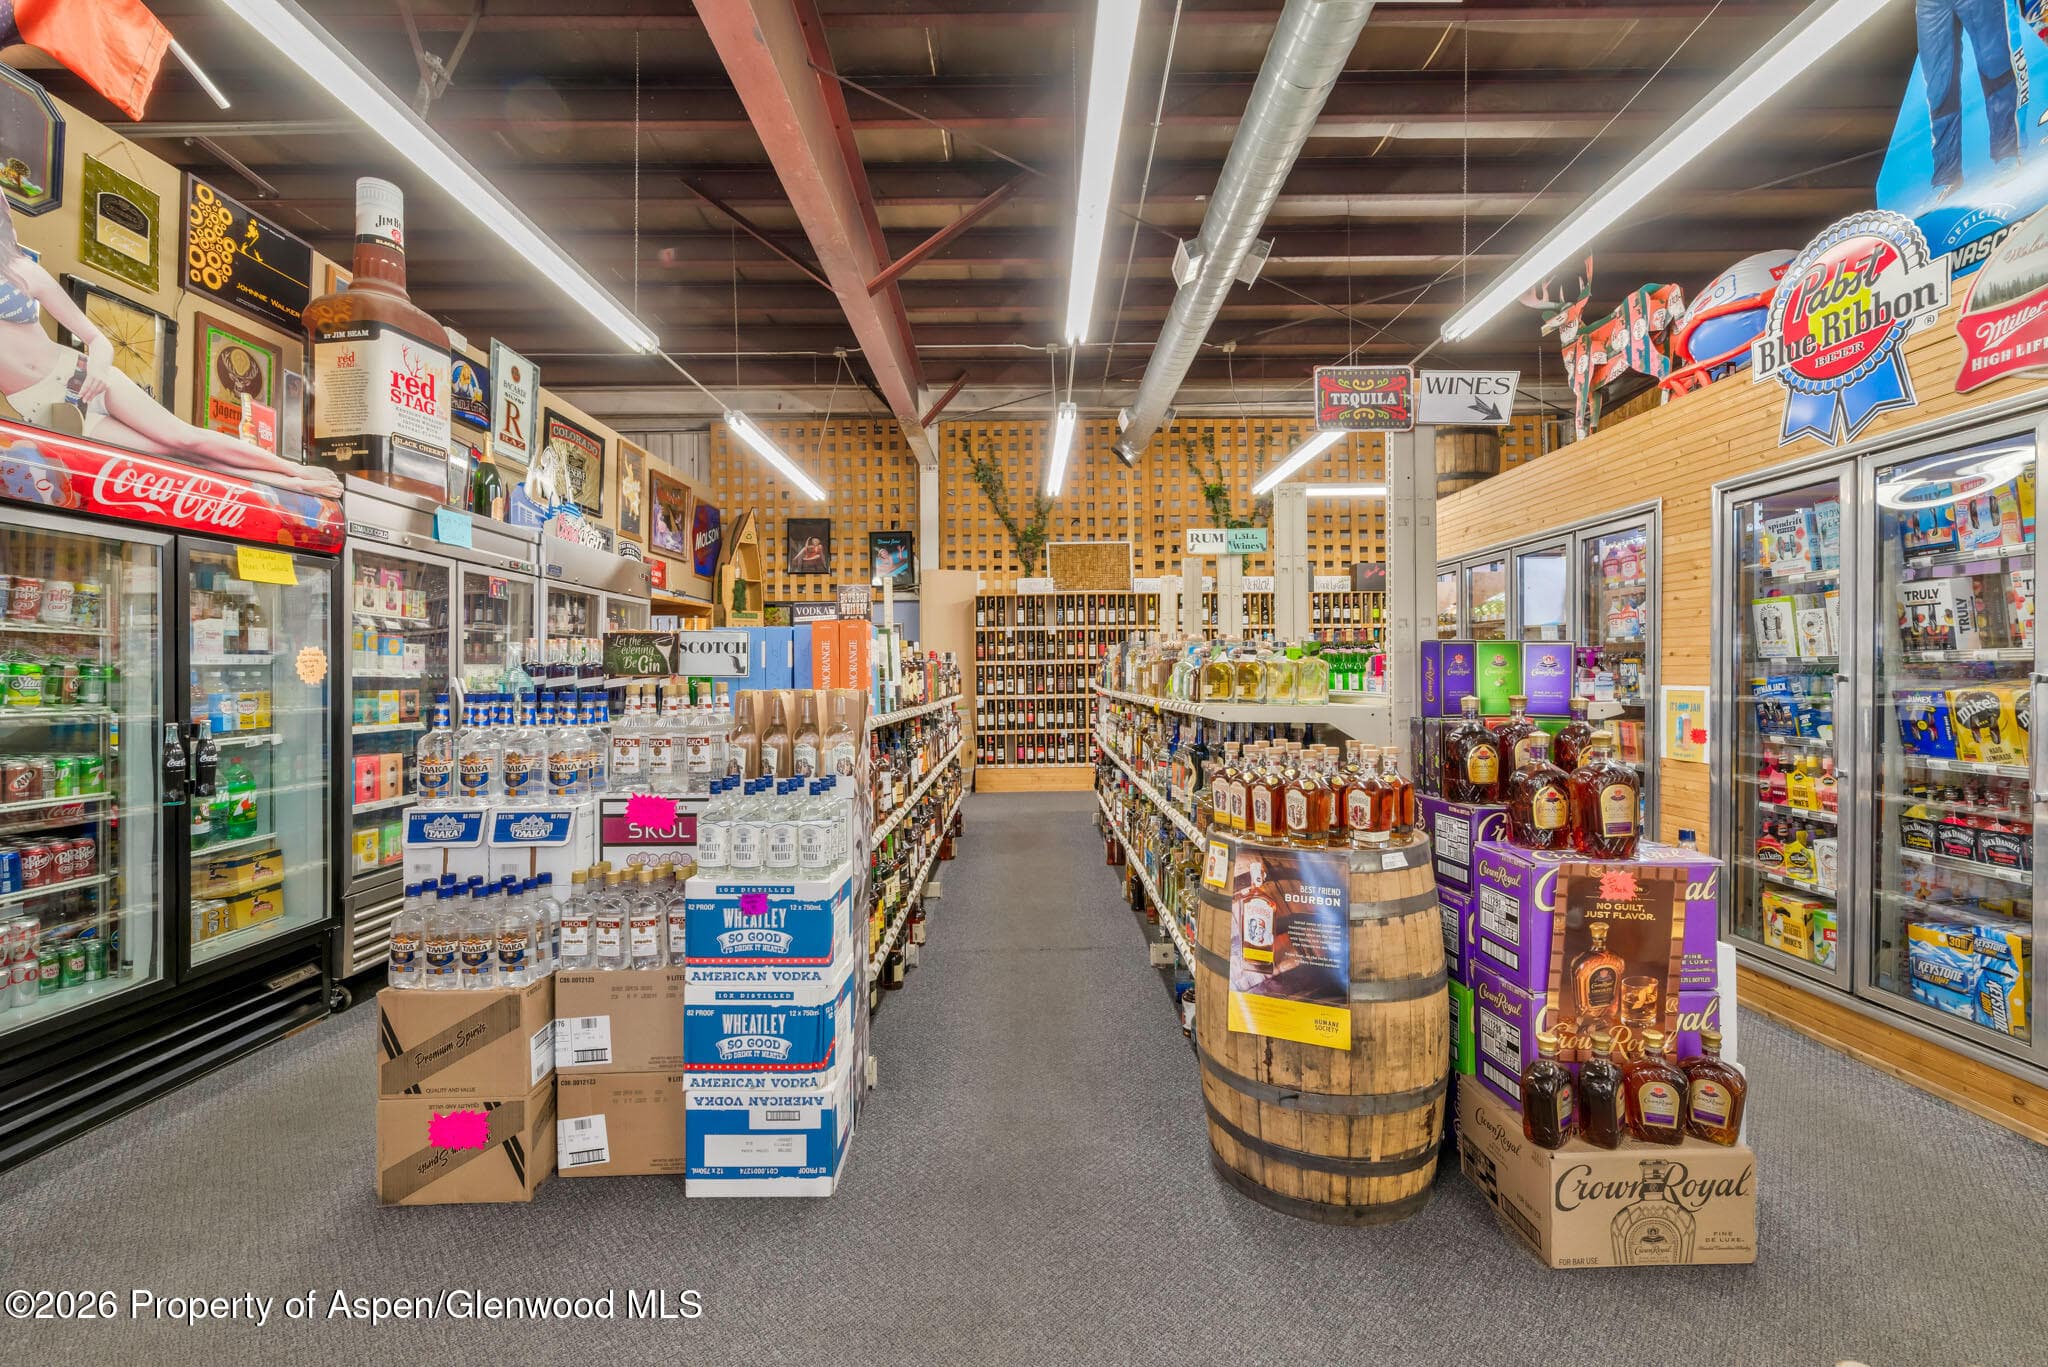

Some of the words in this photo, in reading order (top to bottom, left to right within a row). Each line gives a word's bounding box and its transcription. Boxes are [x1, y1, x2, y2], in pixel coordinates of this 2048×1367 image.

[375, 214, 392, 228] JIM
[1948, 208, 2009, 244] OFFICIAL
[1793, 242, 1886, 321] Pabst
[236, 282, 268, 303] JOHNNIE
[271, 299, 300, 319] WALKER
[332, 330, 346, 339] JIM
[347, 329, 369, 338] BEAM
[1758, 334, 1817, 375] Blue
[1820, 281, 1939, 347] Ribbon
[1975, 301, 2048, 353] Miller
[1813, 341, 1865, 369] BEER
[1971, 349, 2014, 373] HIGH
[390, 370, 437, 403] red
[1426, 377, 1511, 395] WINES
[390, 388, 435, 417] STAG
[1330, 392, 1397, 408] TEQUILA
[501, 399, 525, 440] R
[394, 436, 418, 449] BLACK
[418, 444, 445, 457] CHERRY
[502, 436, 526, 450] RAZ
[552, 425, 599, 456] COLORADO
[93, 455, 245, 528] Coca-Cola
[1768, 517, 1803, 532] spindrift
[579, 526, 607, 550] LIGHT
[696, 528, 720, 549] MOLSON
[1189, 533, 1224, 543] RUM
[1233, 542, 1260, 550] Wines
[1904, 588, 1940, 601] TRULY
[796, 606, 829, 616] VODKA
[1959, 598, 1970, 634] TRULY
[615, 635, 627, 648] Let
[629, 634, 641, 646] the
[680, 641, 747, 654] SCOTCH
[621, 646, 654, 656] evening
[623, 655, 638, 669] Be
[638, 655, 660, 674] Gin
[1957, 695, 1999, 724] mike's
[615, 739, 638, 747] SKOL
[649, 739, 669, 747] SKOL
[687, 738, 709, 747] SKOL
[420, 764, 449, 774] TAAKA
[460, 764, 488, 774] TAAKA
[549, 763, 578, 773] TAAKA
[427, 829, 460, 839] TAAKA
[514, 829, 548, 839] TAAKA
[628, 822, 691, 839] SKOL
[1939, 830, 1952, 840] JACK
[1951, 829, 1975, 845] DANIEL'S
[771, 843, 794, 852] WHEATLEY
[1982, 838, 1996, 848] JACK
[1995, 836, 2020, 853] DANIEL'S
[1479, 860, 1501, 884] Crown
[1498, 866, 1521, 888] Royal
[1300, 885, 1316, 895] BEST
[1317, 886, 1341, 897] FRIEND
[1284, 893, 1341, 907] BOURBON
[1596, 902, 1612, 910] NO
[1614, 903, 1645, 912] GUILT,
[722, 907, 787, 929] WHEATLEY
[1584, 911, 1611, 919] JUST
[1612, 911, 1656, 921] FLAVOR.
[563, 919, 585, 928] SKOL
[597, 920, 618, 928] SKOL
[631, 919, 652, 928] SKOL
[728, 933, 745, 944] SO
[747, 932, 782, 944] GOOD
[1948, 935, 1961, 948] 30
[391, 942, 415, 951] TAAKA
[427, 944, 454, 953] TAAKA
[462, 943, 488, 952] TAAKA
[499, 942, 523, 952] TAAKA
[1974, 937, 2007, 954] KEYSTONE
[691, 971, 767, 981] AMERICAN
[771, 971, 822, 981] VODKA
[1917, 960, 1965, 983] KEYSTONE
[1478, 983, 1501, 1008] Crown
[1497, 991, 1522, 1017] Royal
[1986, 979, 2009, 1034] KEYSTONE
[695, 1009, 715, 1017] PROOF
[721, 1014, 786, 1035] WHEATLEY
[1314, 1019, 1339, 1028] HUMANE
[1314, 1025, 1339, 1034] SOCIETY
[414, 1041, 454, 1069] Premium
[456, 1022, 488, 1049] Spirits
[727, 1039, 743, 1050] SO
[747, 1039, 781, 1050] GOOD
[690, 1078, 766, 1088] AMERICAN
[771, 1077, 818, 1088] VODKA
[693, 1096, 744, 1106] VODKA
[749, 1096, 825, 1106] AMERICAN
[1475, 1107, 1499, 1133] Crown
[1496, 1124, 1522, 1156] Royal
[416, 1151, 449, 1174] Spirits
[1554, 1163, 1647, 1213] Crown
[1662, 1161, 1752, 1213] Royal
[1558, 1258, 1571, 1266] FOR
[1572, 1257, 1586, 1266] BAR
[1587, 1256, 1599, 1265] USE
